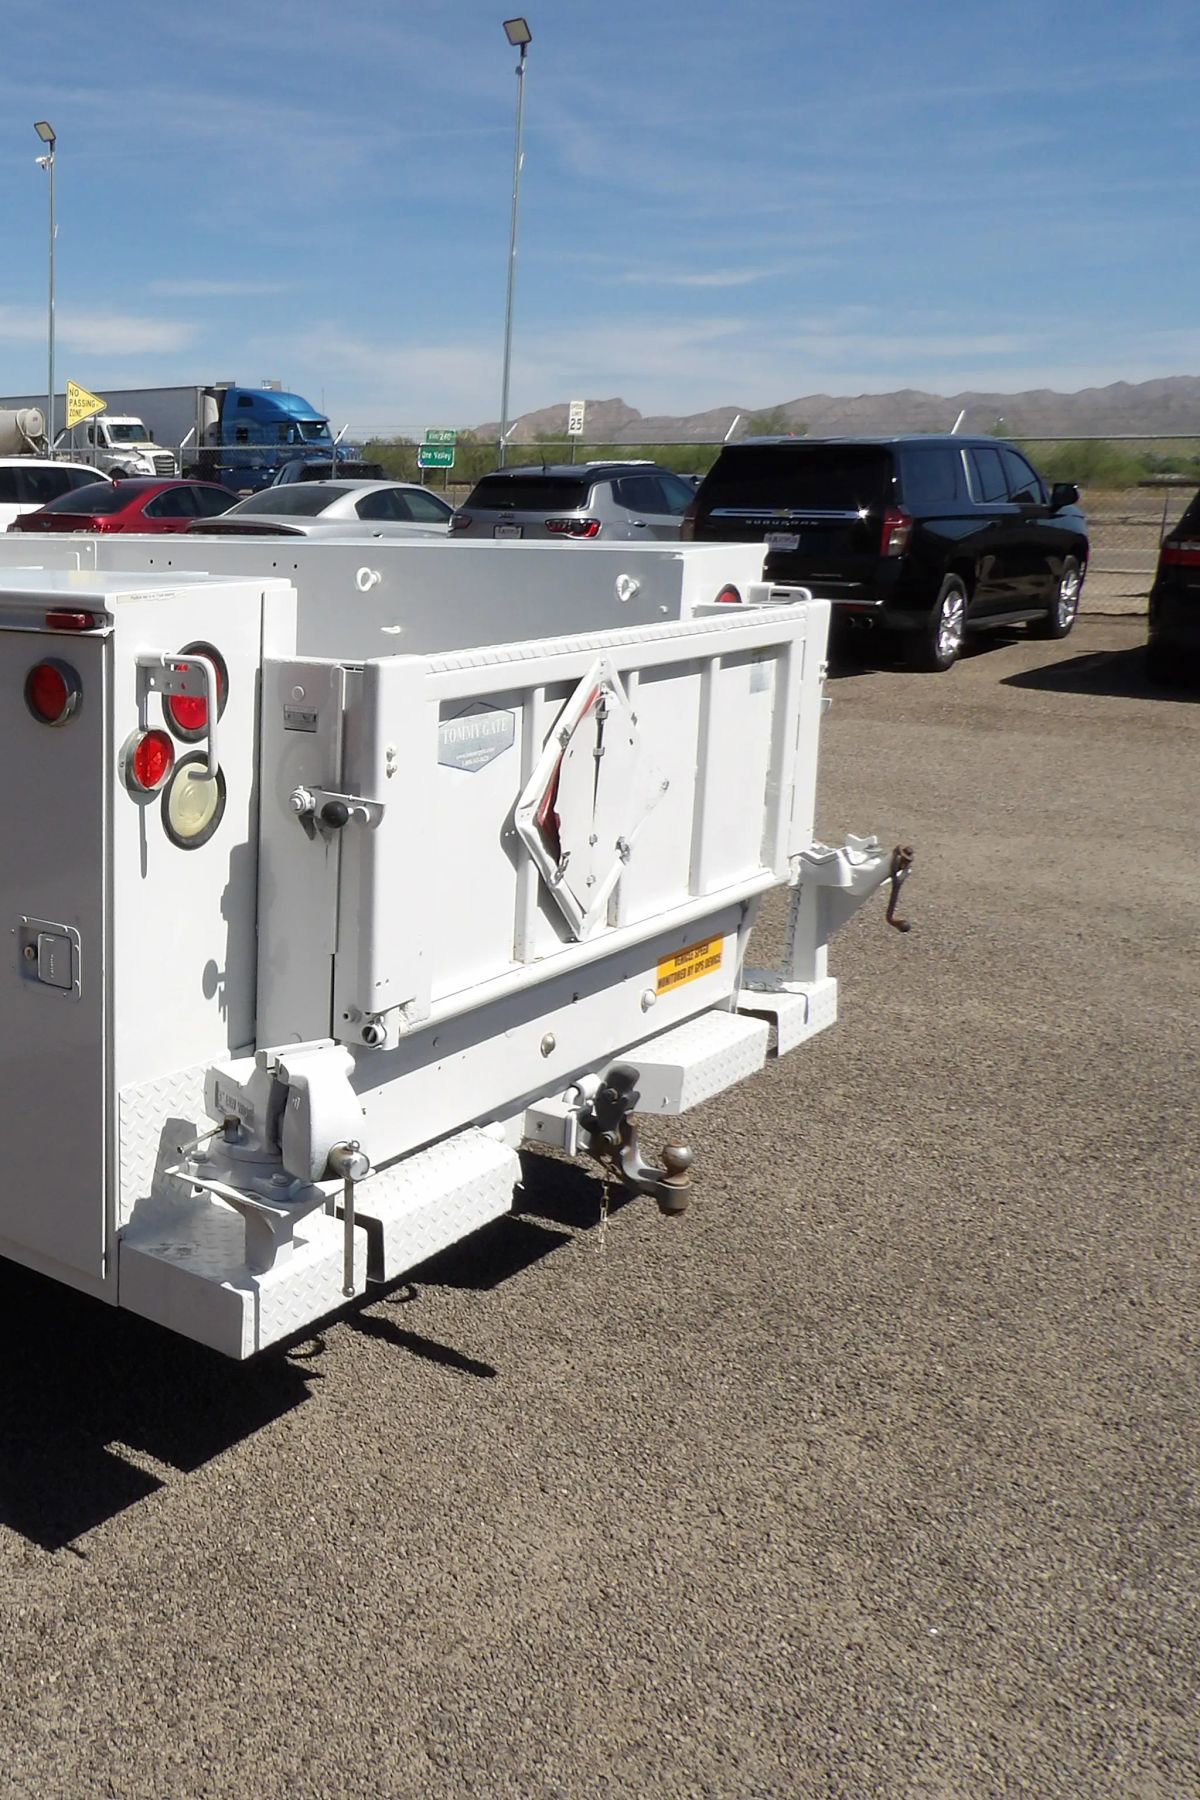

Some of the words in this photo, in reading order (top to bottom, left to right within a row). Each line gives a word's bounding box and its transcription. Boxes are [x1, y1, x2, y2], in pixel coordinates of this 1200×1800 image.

[69, 387, 80, 397] NO
[69, 399, 96, 408] PASSING
[570, 418, 582, 430] 25
[443, 721, 480, 745] TOMMY
